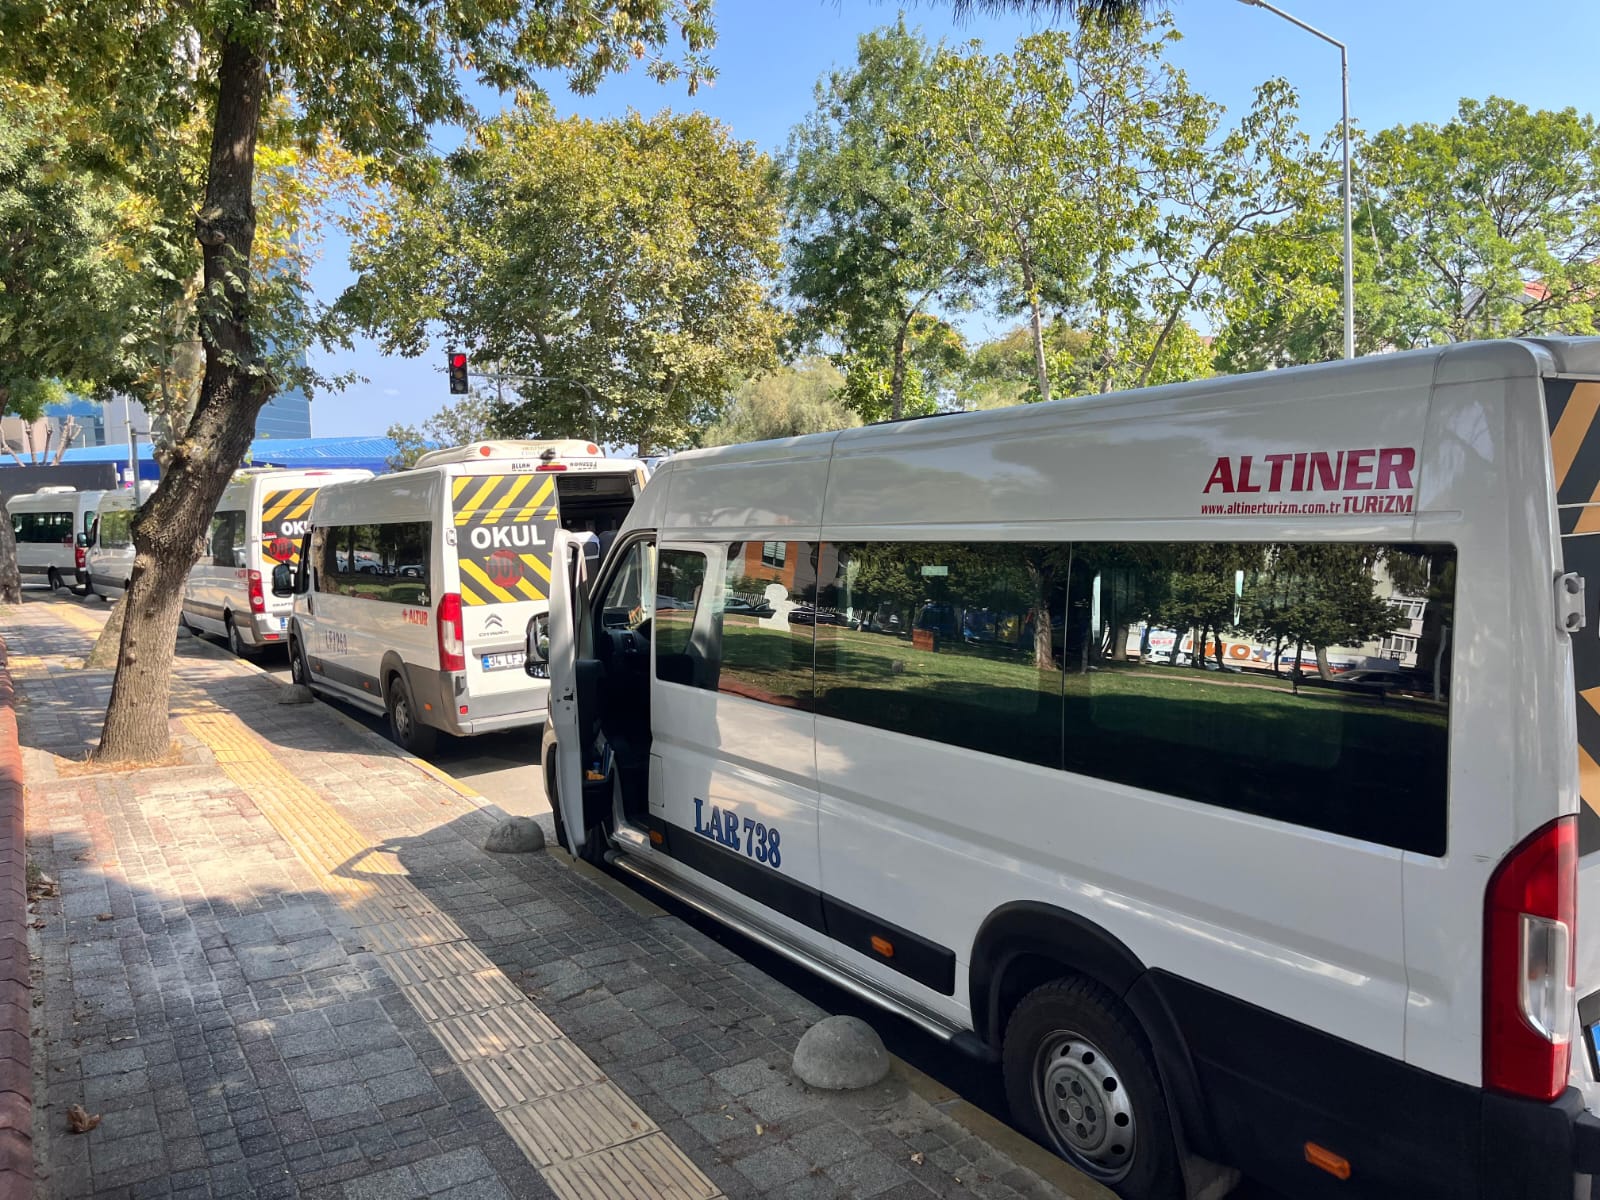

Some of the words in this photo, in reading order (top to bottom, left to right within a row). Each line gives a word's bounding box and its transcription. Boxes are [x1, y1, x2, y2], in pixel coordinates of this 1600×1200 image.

[1202, 447, 1416, 493] ALTINER
[1201, 501, 1341, 515] www.altinerturizm.com.tr
[471, 524, 546, 549] OKUL
[409, 608, 428, 626] ALTUR
[488, 655, 502, 667] 34
[504, 651, 524, 666] LFJ
[693, 797, 740, 852] LAR
[743, 817, 781, 869] 738
